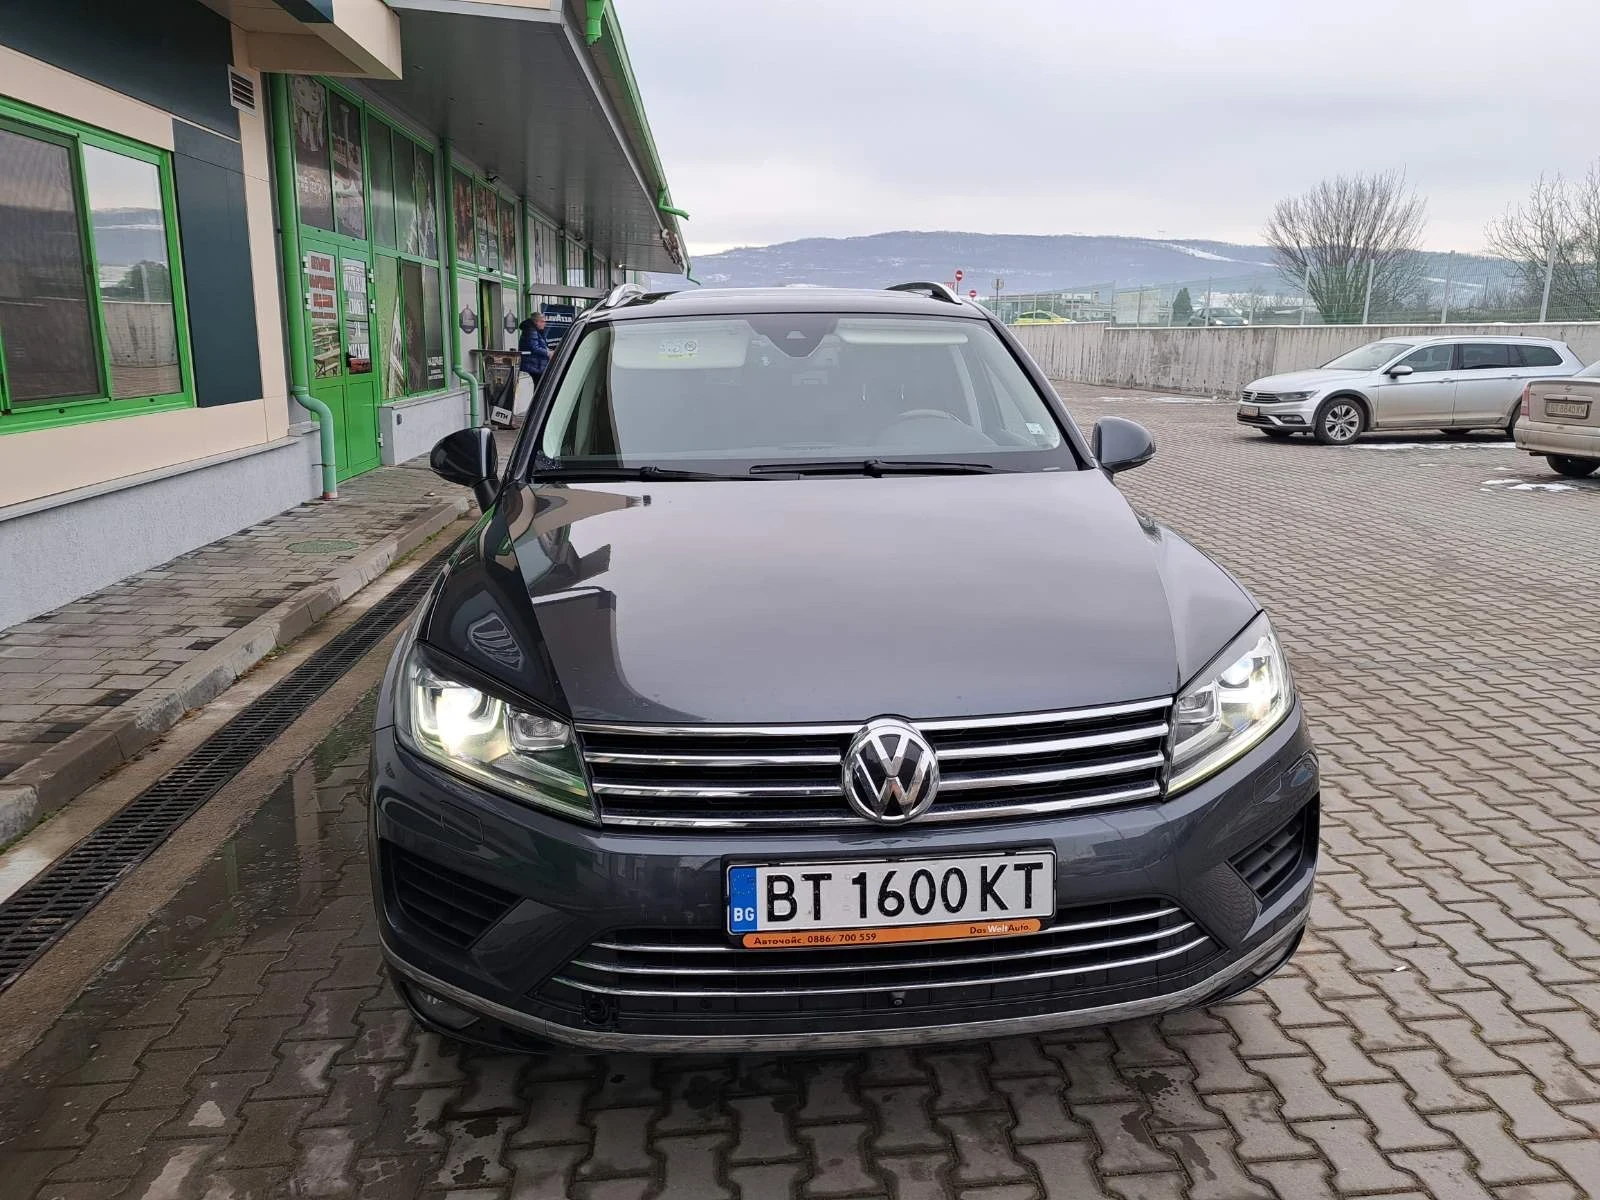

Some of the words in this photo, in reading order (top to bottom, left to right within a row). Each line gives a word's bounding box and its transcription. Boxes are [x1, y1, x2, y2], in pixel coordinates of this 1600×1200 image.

[766, 873, 832, 922] BT
[851, 866, 968, 919] 1600
[980, 862, 1044, 912] KT
[733, 907, 755, 922] BG
[969, 926, 987, 934] Das
[807, 935, 835, 943] 0886/
[839, 934, 857, 942] 700
[859, 932, 877, 941] 559
